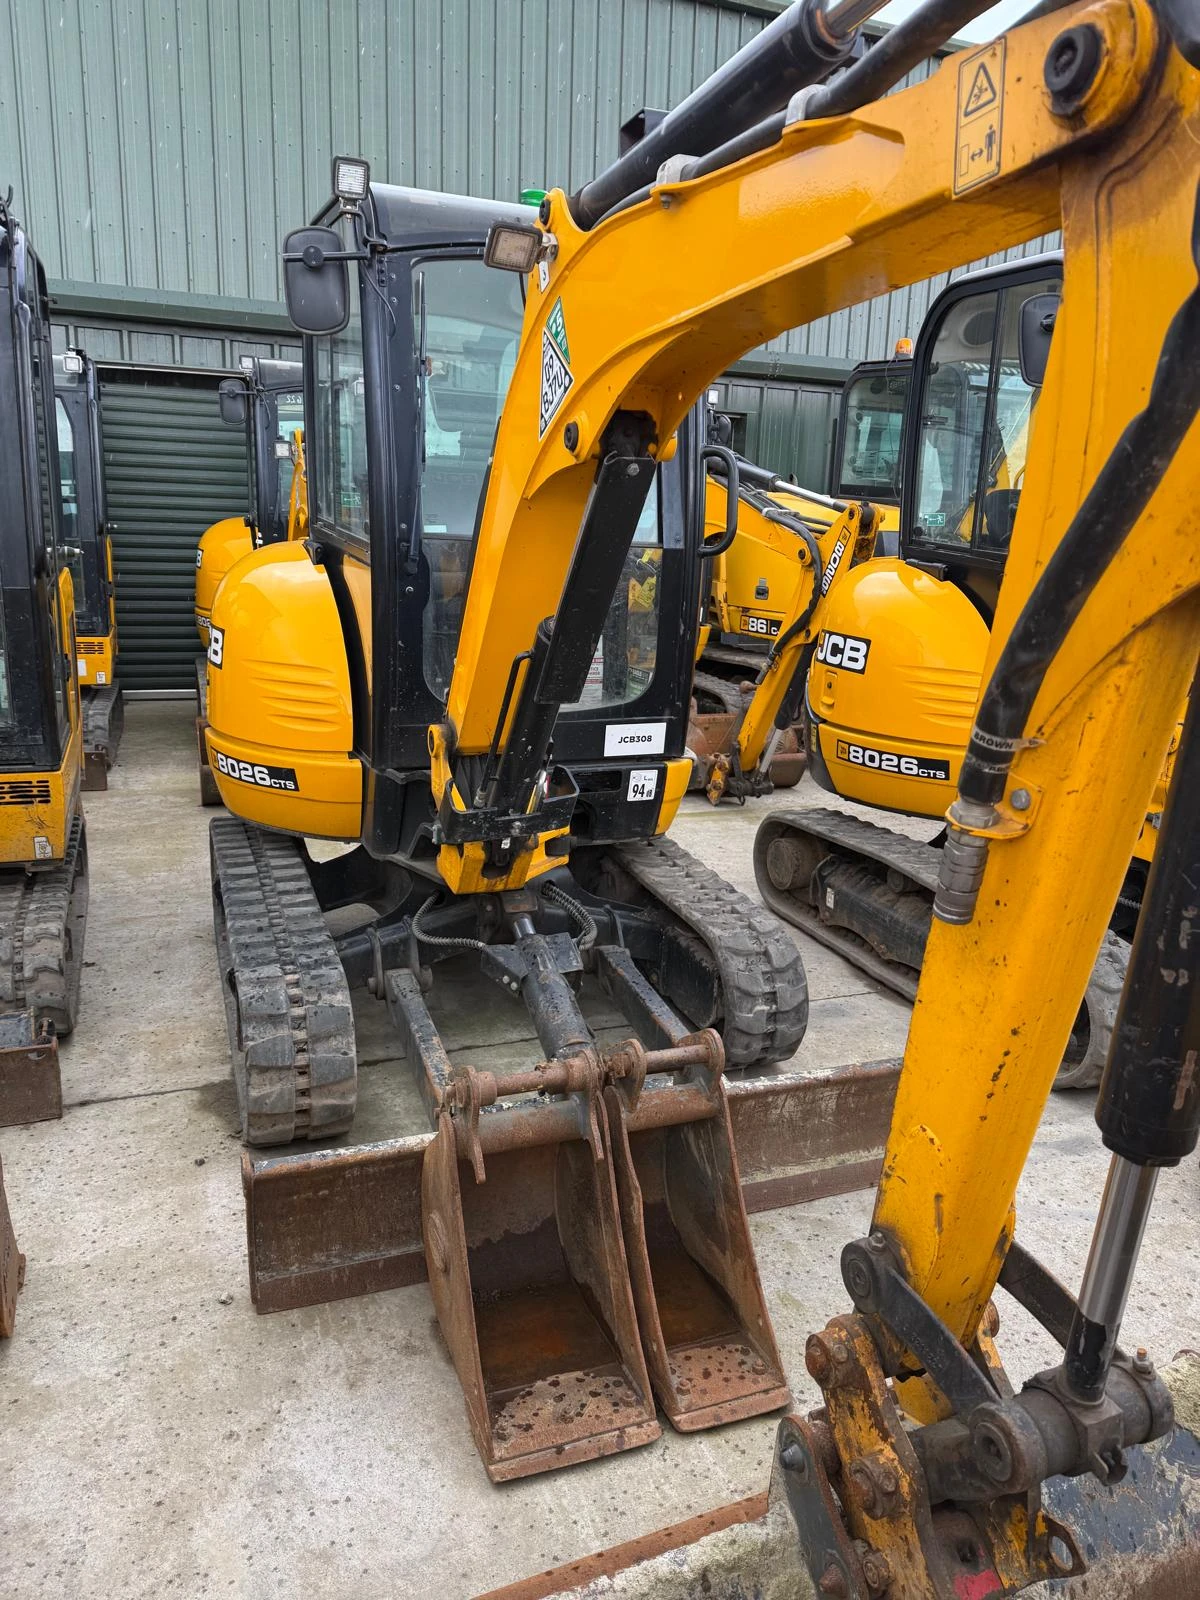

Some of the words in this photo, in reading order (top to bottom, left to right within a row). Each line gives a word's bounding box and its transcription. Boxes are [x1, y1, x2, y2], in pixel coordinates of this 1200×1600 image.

[748, 617, 767, 633] 86
[817, 633, 868, 670] JCB
[618, 735, 653, 743] JCB308
[973, 731, 1014, 749] BROWN
[632, 784, 645, 798] 94
